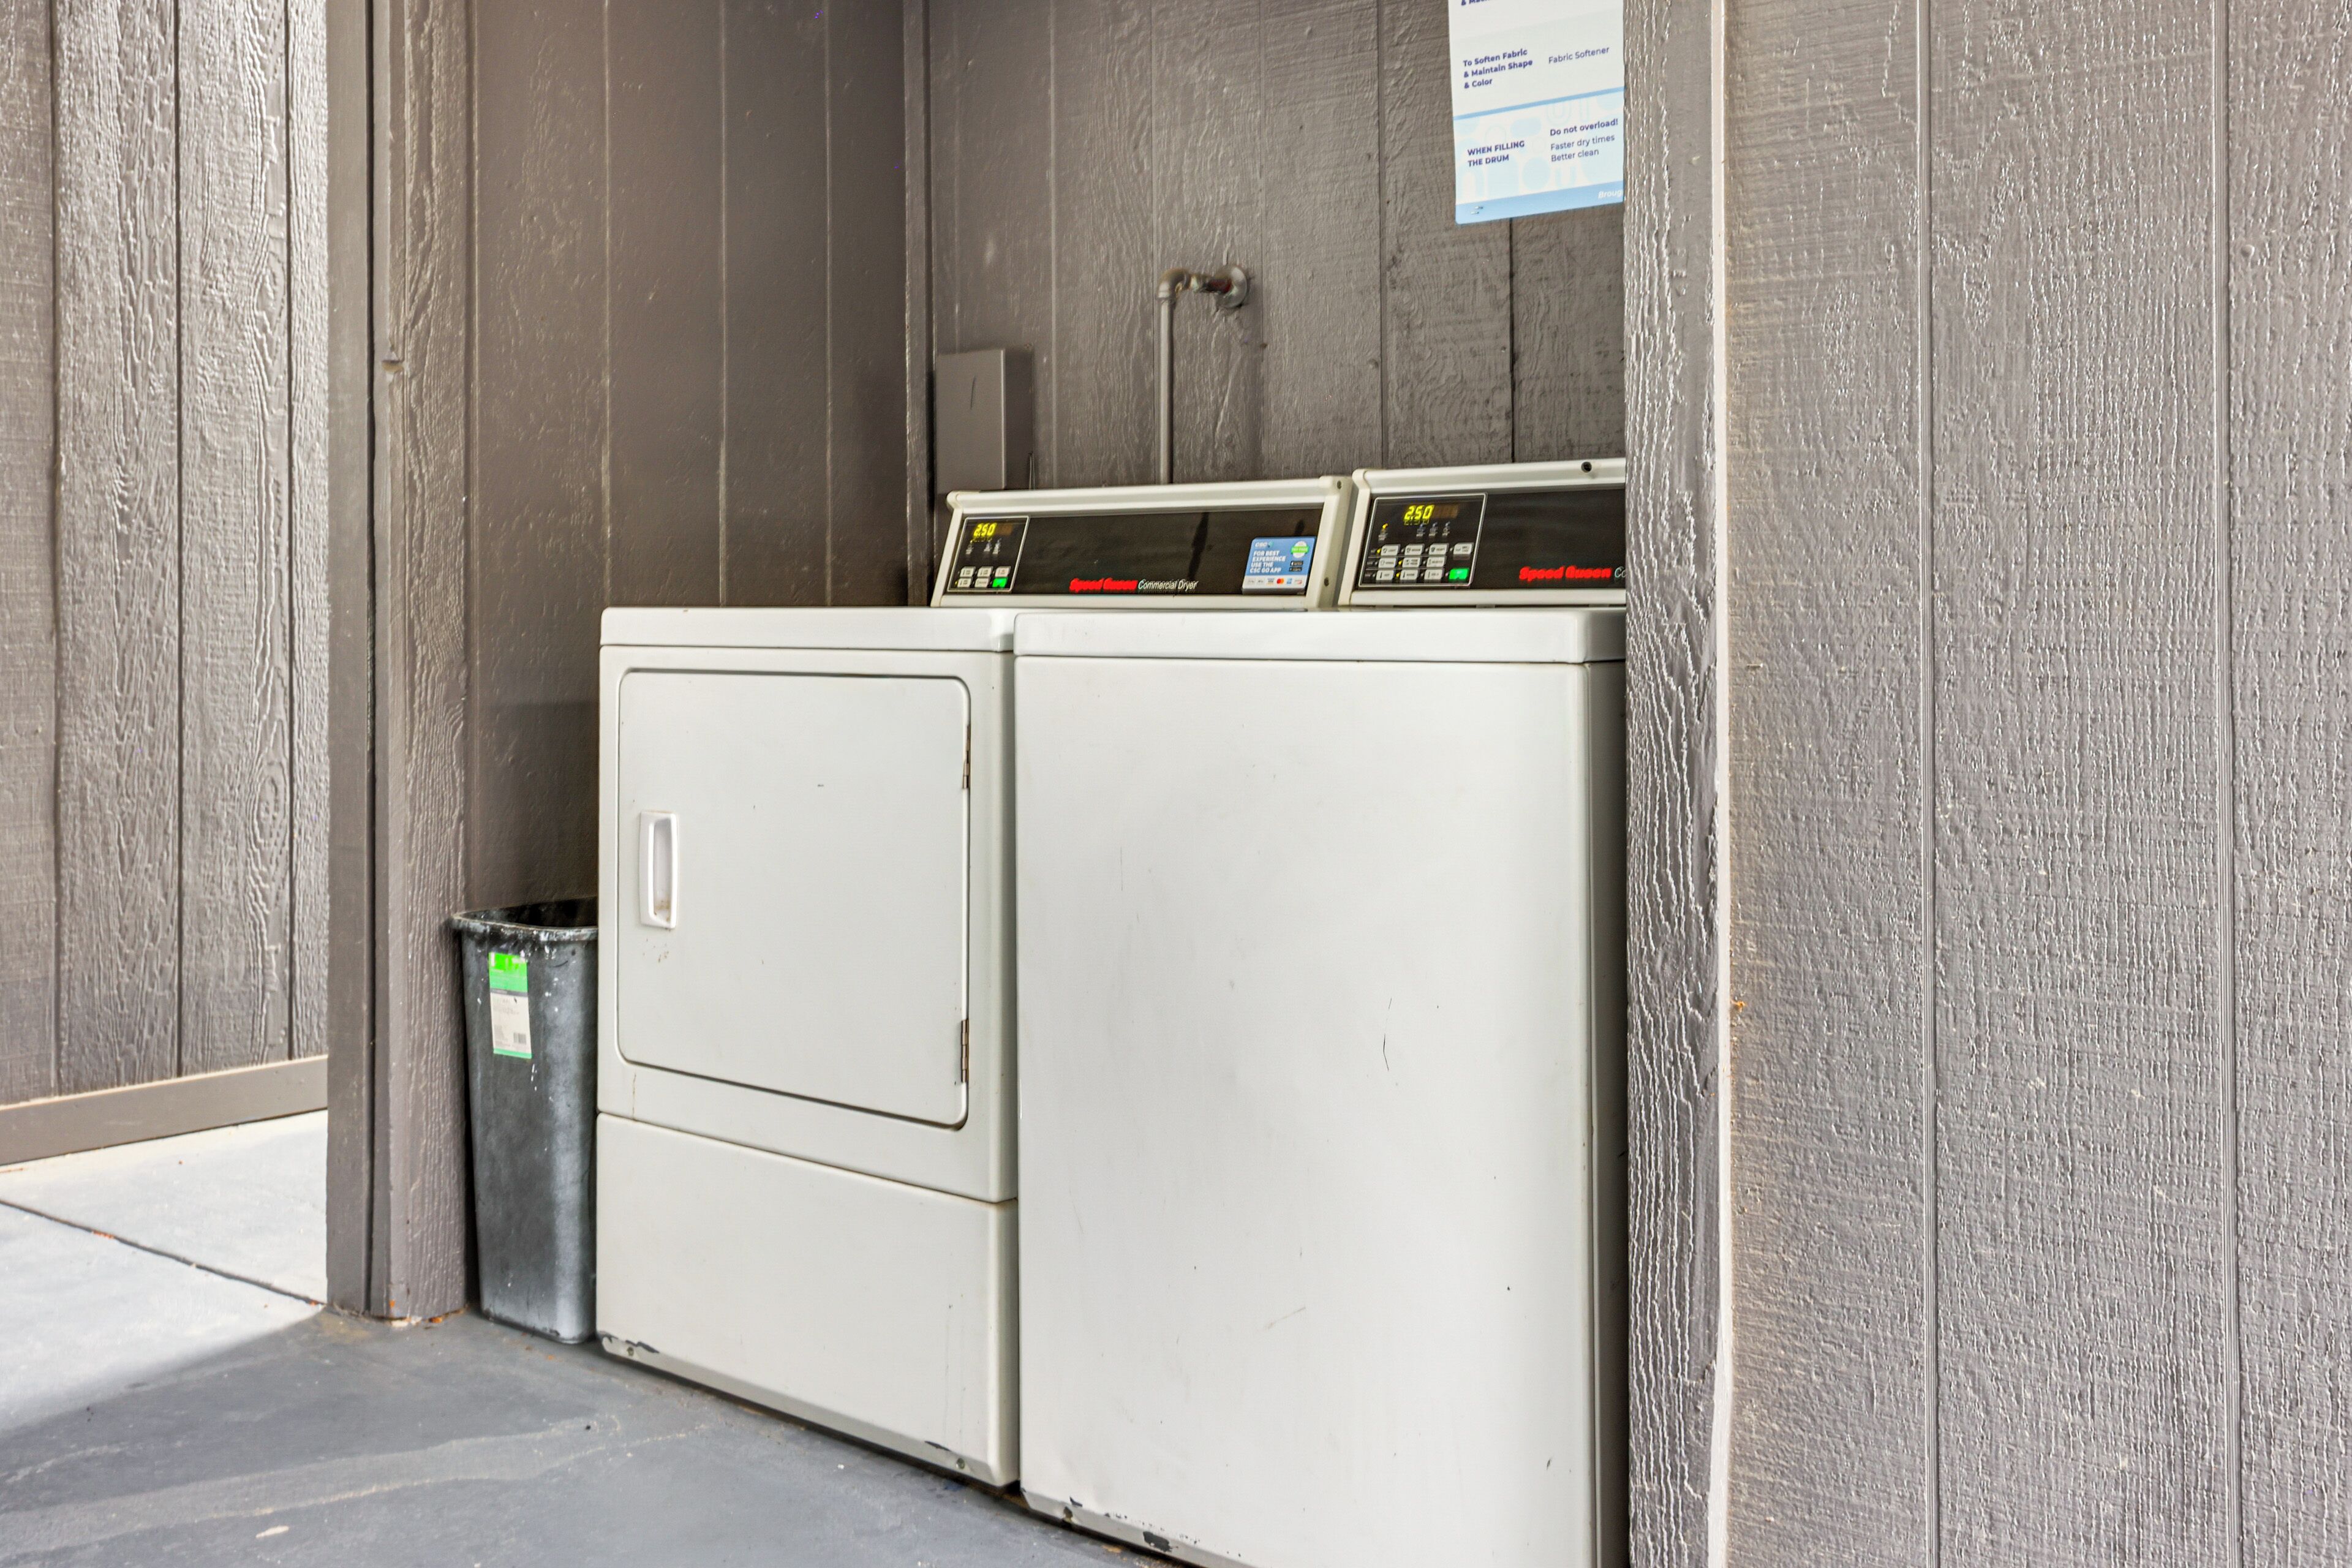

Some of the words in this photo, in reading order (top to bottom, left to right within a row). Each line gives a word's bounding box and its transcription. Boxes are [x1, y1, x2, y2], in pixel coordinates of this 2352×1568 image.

[1474, 55, 1500, 65] Soften
[1502, 48, 1528, 59] Fabric
[1548, 53, 1573, 64] Fabric
[1575, 47, 1609, 59] Softener
[1471, 64, 1506, 77] Maintain
[1508, 60, 1532, 69] Shape
[1472, 78, 1493, 87] Color
[1563, 126, 1577, 134] not
[1580, 118, 1618, 131] overload!
[1467, 146, 1492, 156] WHEN
[1494, 140, 1525, 152] FILLING
[1551, 141, 1575, 151] Faster
[1577, 138, 1590, 147] dry
[1592, 135, 1615, 144] times
[1468, 159, 1482, 167] THE
[1485, 154, 1509, 164] DRUM
[1551, 153, 1575, 162] Better
[1577, 149, 1599, 157] clean
[1519, 566, 1565, 582] Speed
[1566, 565, 1612, 579] Queen
[1138, 578, 1177, 590] Commercial
[1177, 578, 1199, 592] Dryer
